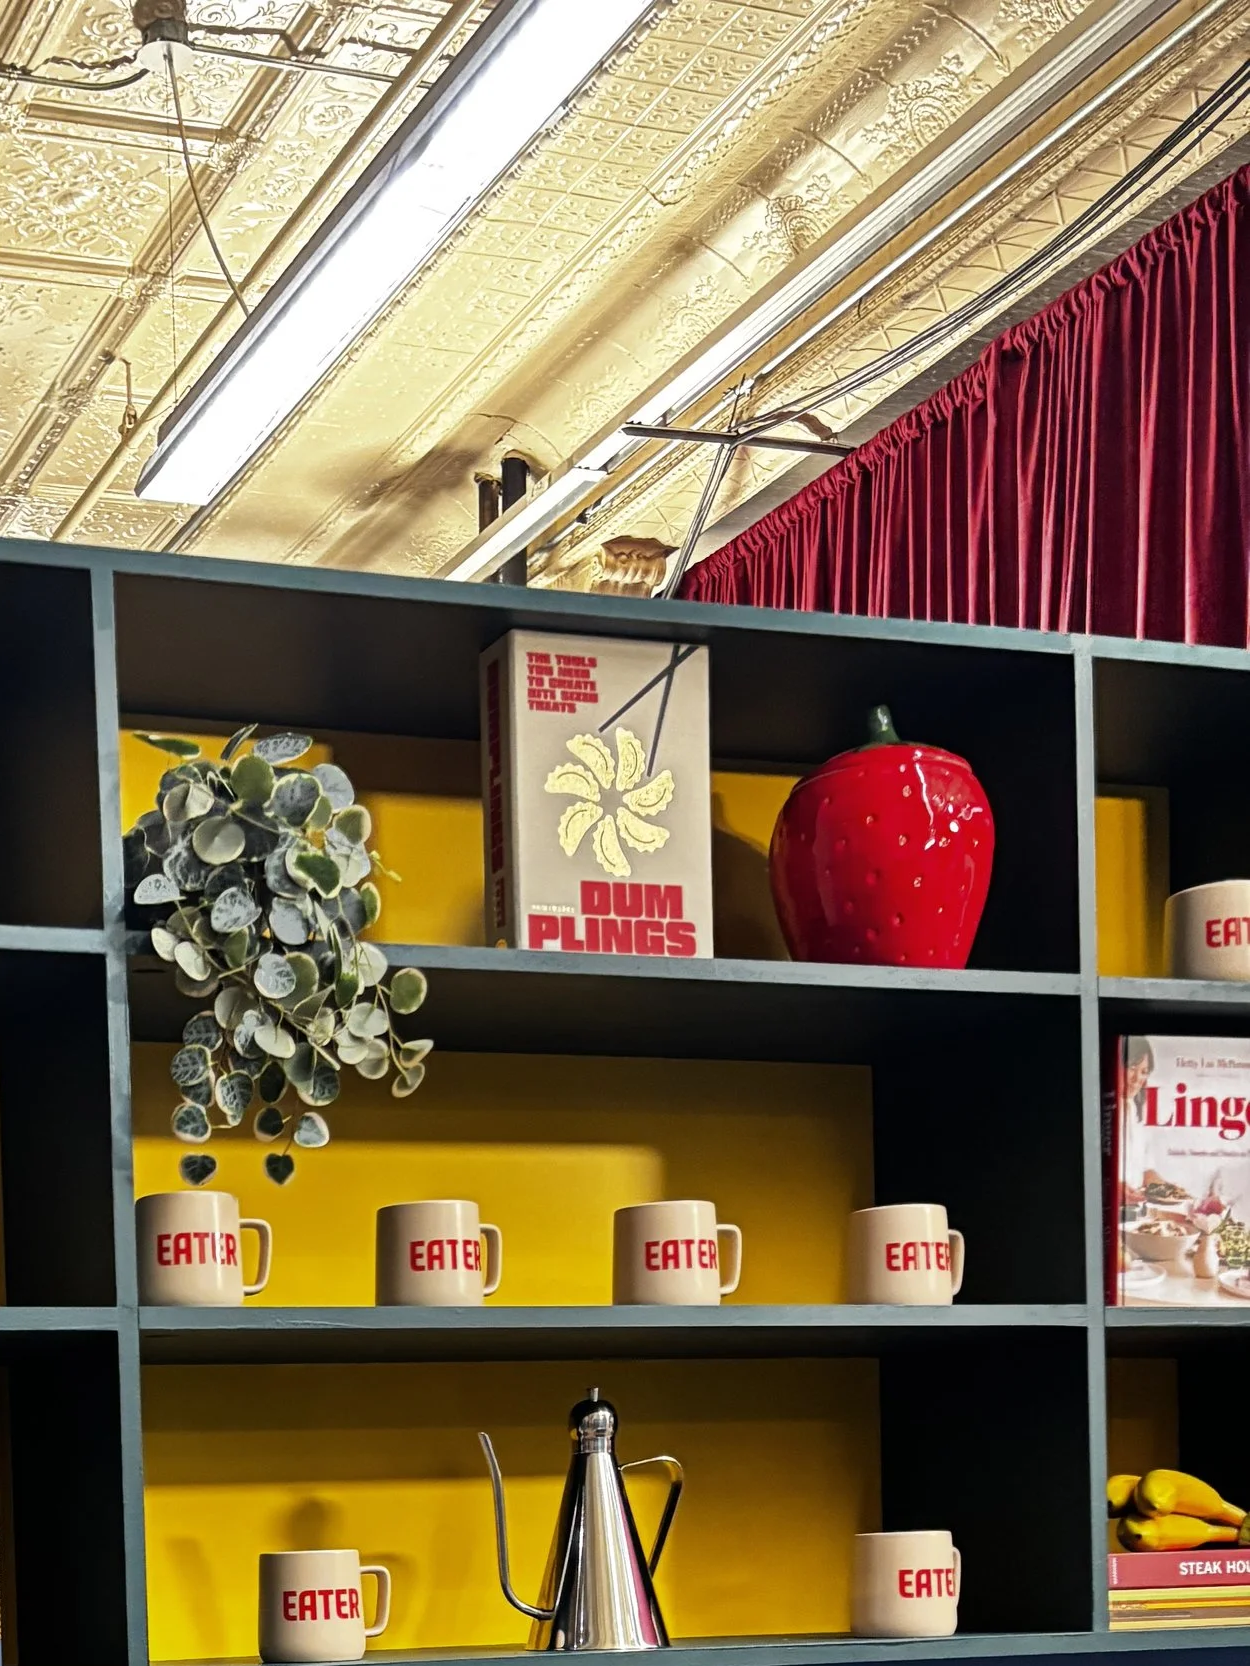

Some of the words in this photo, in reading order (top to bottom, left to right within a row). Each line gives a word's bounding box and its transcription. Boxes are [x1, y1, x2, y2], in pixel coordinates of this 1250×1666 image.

[580, 880, 684, 920] DUM
[528, 914, 697, 957] PLINGS
[1144, 1082, 1250, 1141] Ling
[409, 1239, 482, 1272] EATER
[645, 1239, 718, 1272] EATER
[1179, 1560, 1222, 1576] STEAK
[282, 1588, 360, 1622] EATER
